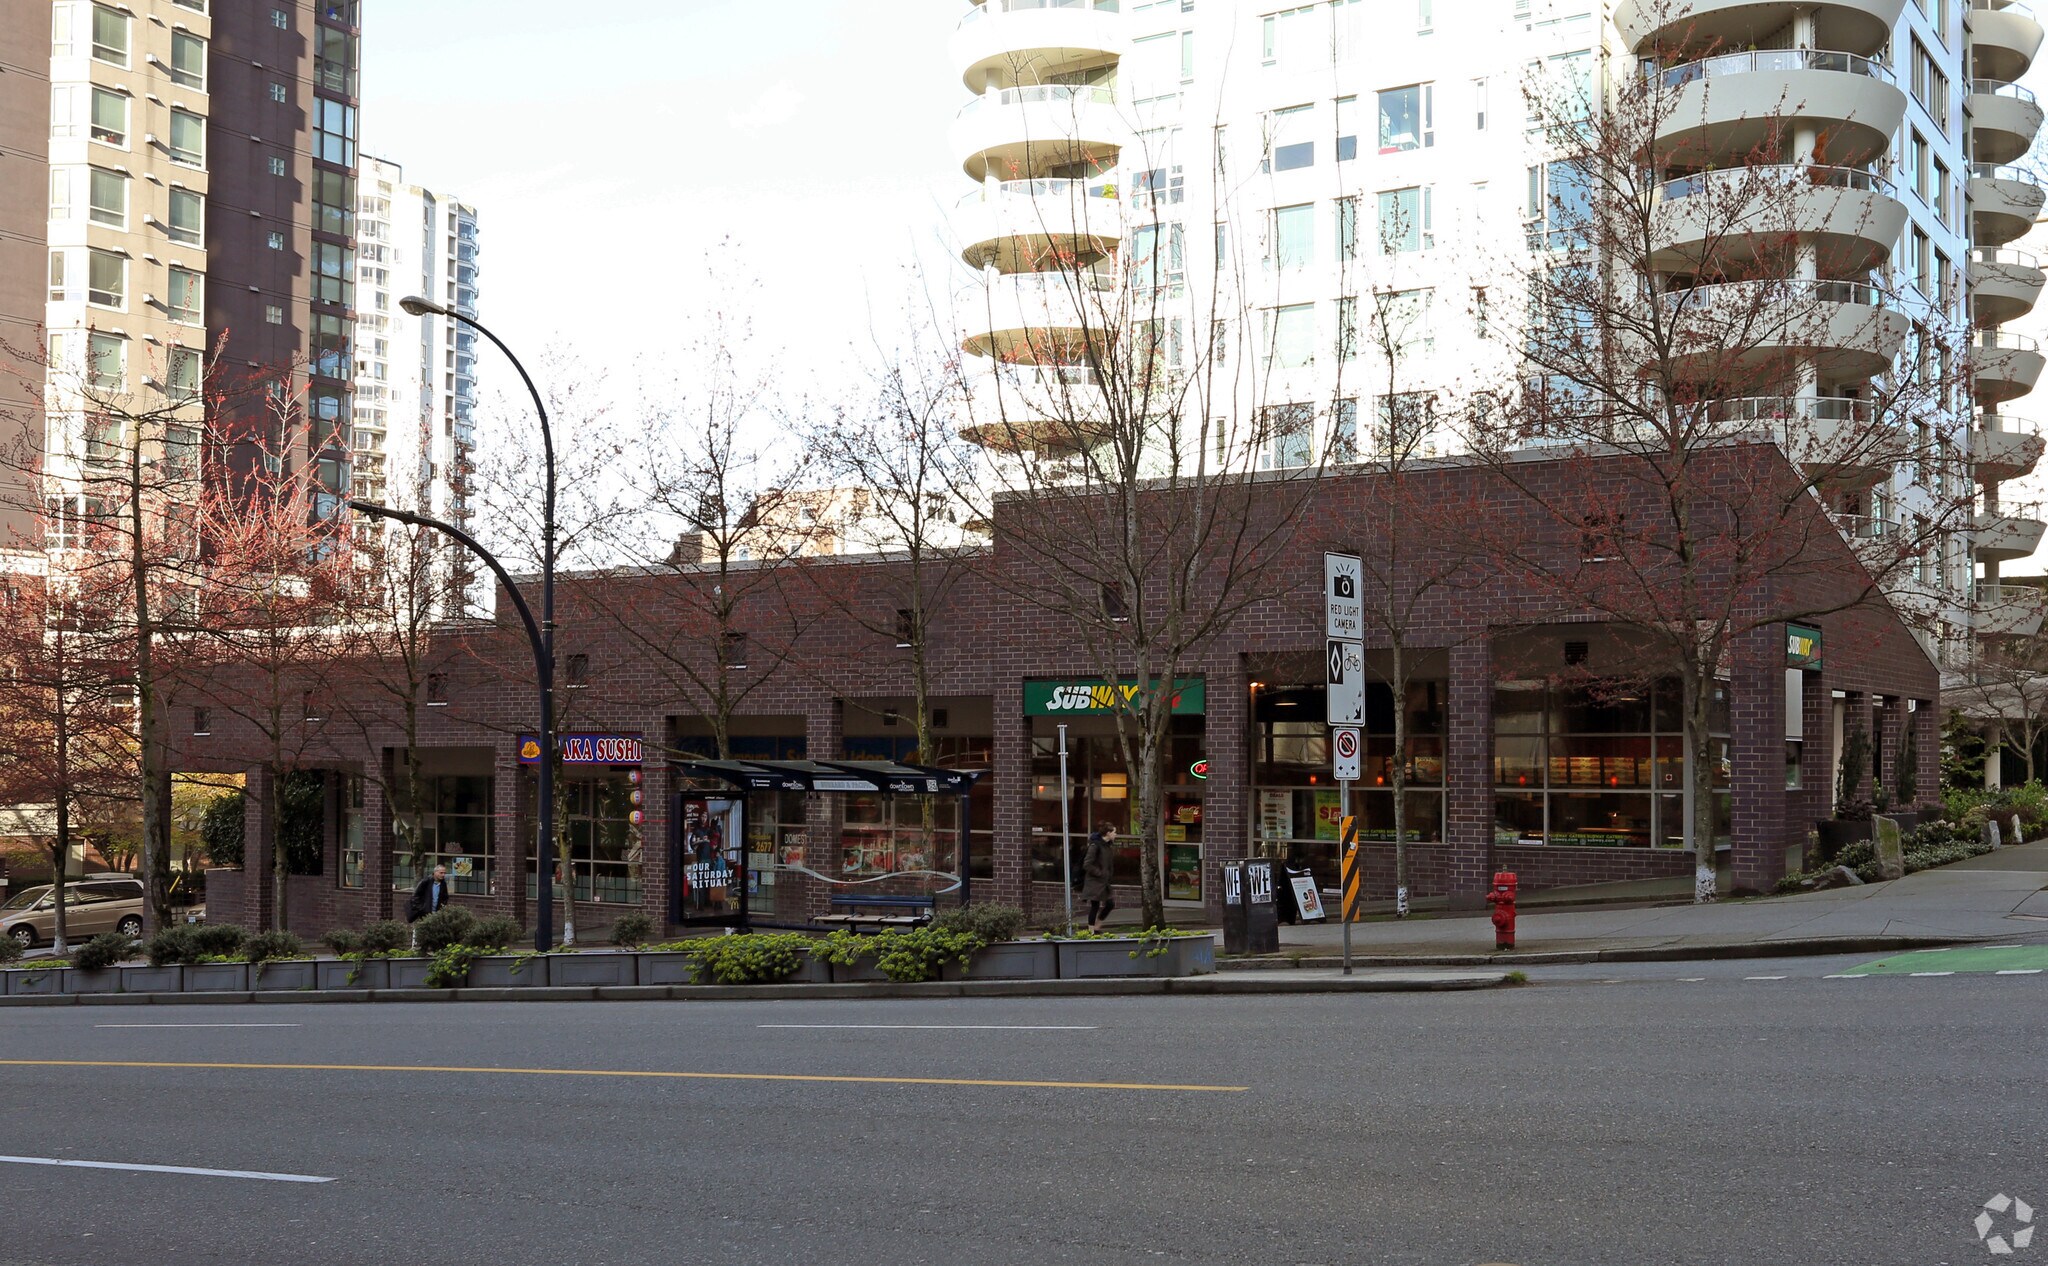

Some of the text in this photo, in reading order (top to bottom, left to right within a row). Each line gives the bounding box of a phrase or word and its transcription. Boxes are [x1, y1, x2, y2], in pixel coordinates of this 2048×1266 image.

[1330, 604, 1359, 617] RED LIGHT
[1334, 618, 1356, 630] CAMERA
[1787, 635, 1814, 657] SUBWAY
[558, 738, 642, 762] AKA SUSHI
[756, 841, 772, 852] 2677
[686, 869, 734, 881] SATURDAY
[1225, 868, 1240, 896] WE
